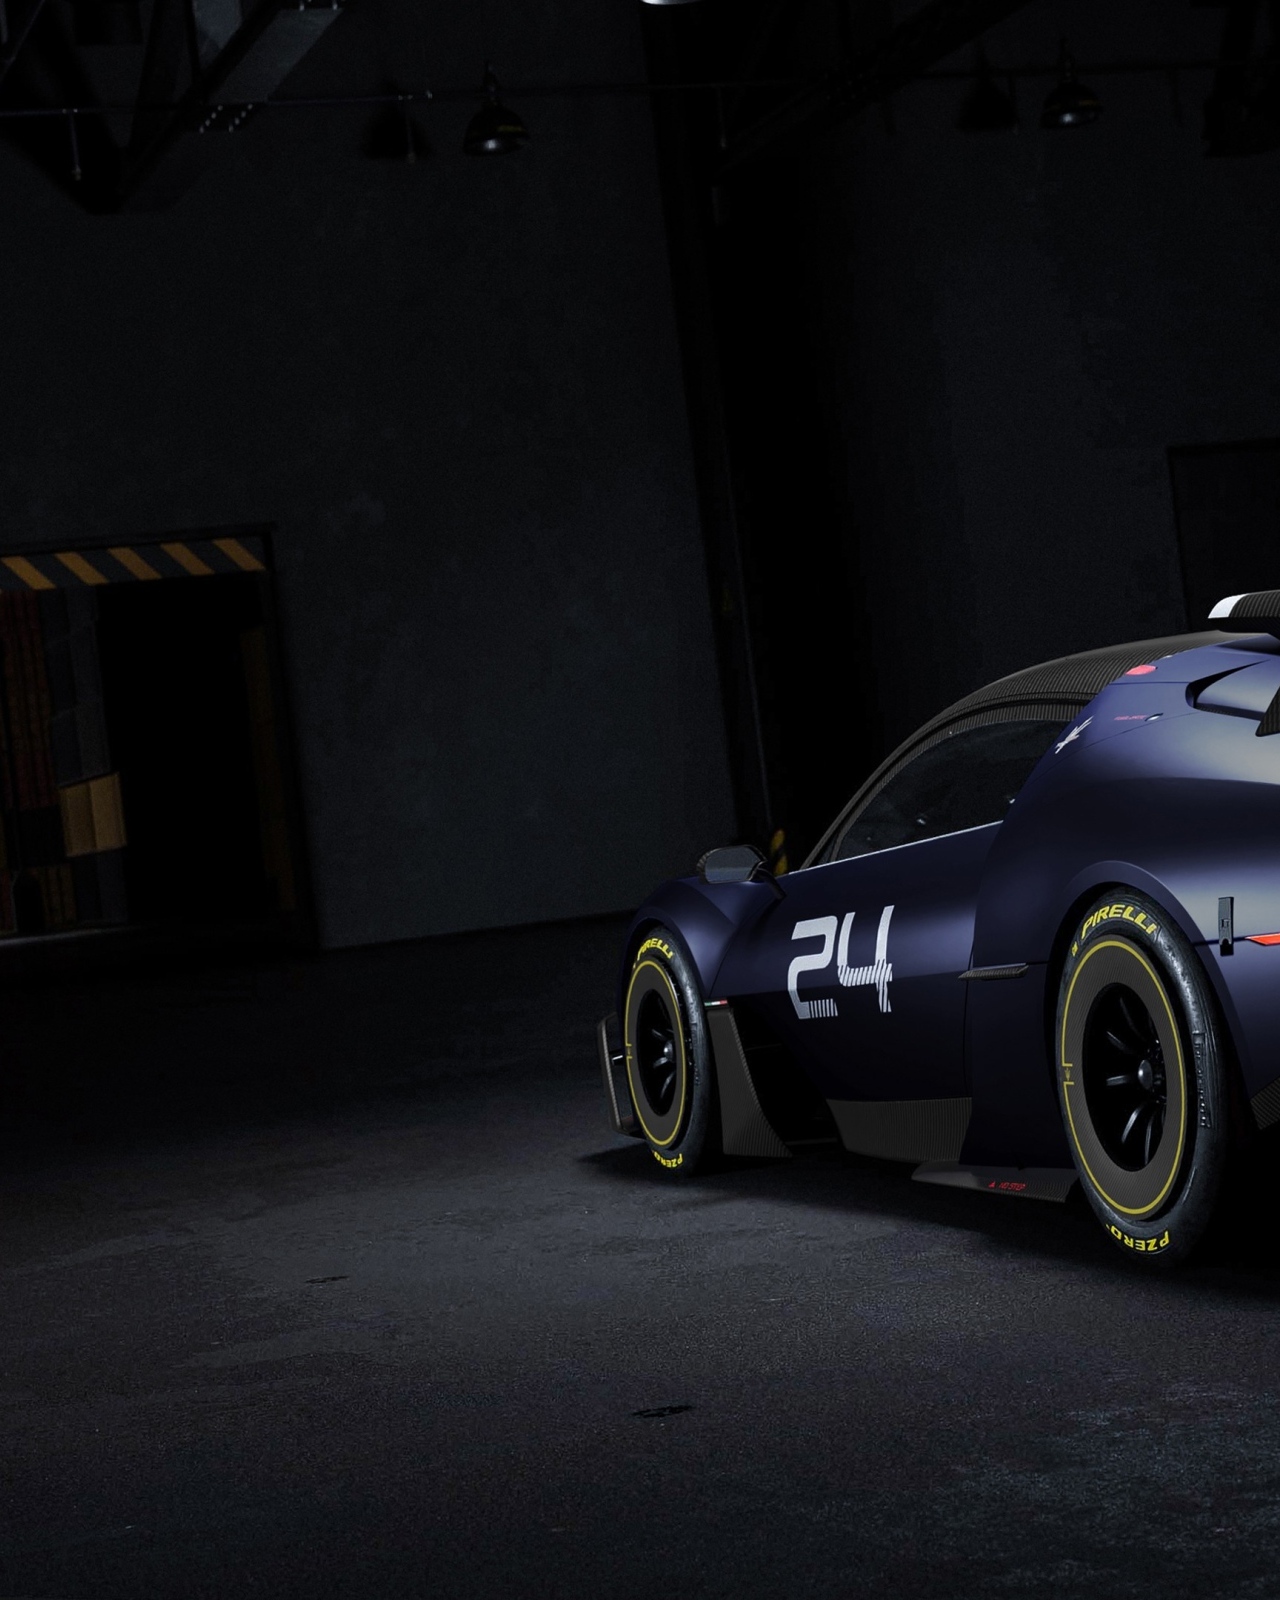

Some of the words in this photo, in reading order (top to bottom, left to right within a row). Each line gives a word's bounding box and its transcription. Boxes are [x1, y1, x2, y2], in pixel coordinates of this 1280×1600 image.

[1081, 903, 1158, 940] PIRELLI
[636, 937, 674, 962] PIRELLI
[787, 904, 896, 1020] 24
